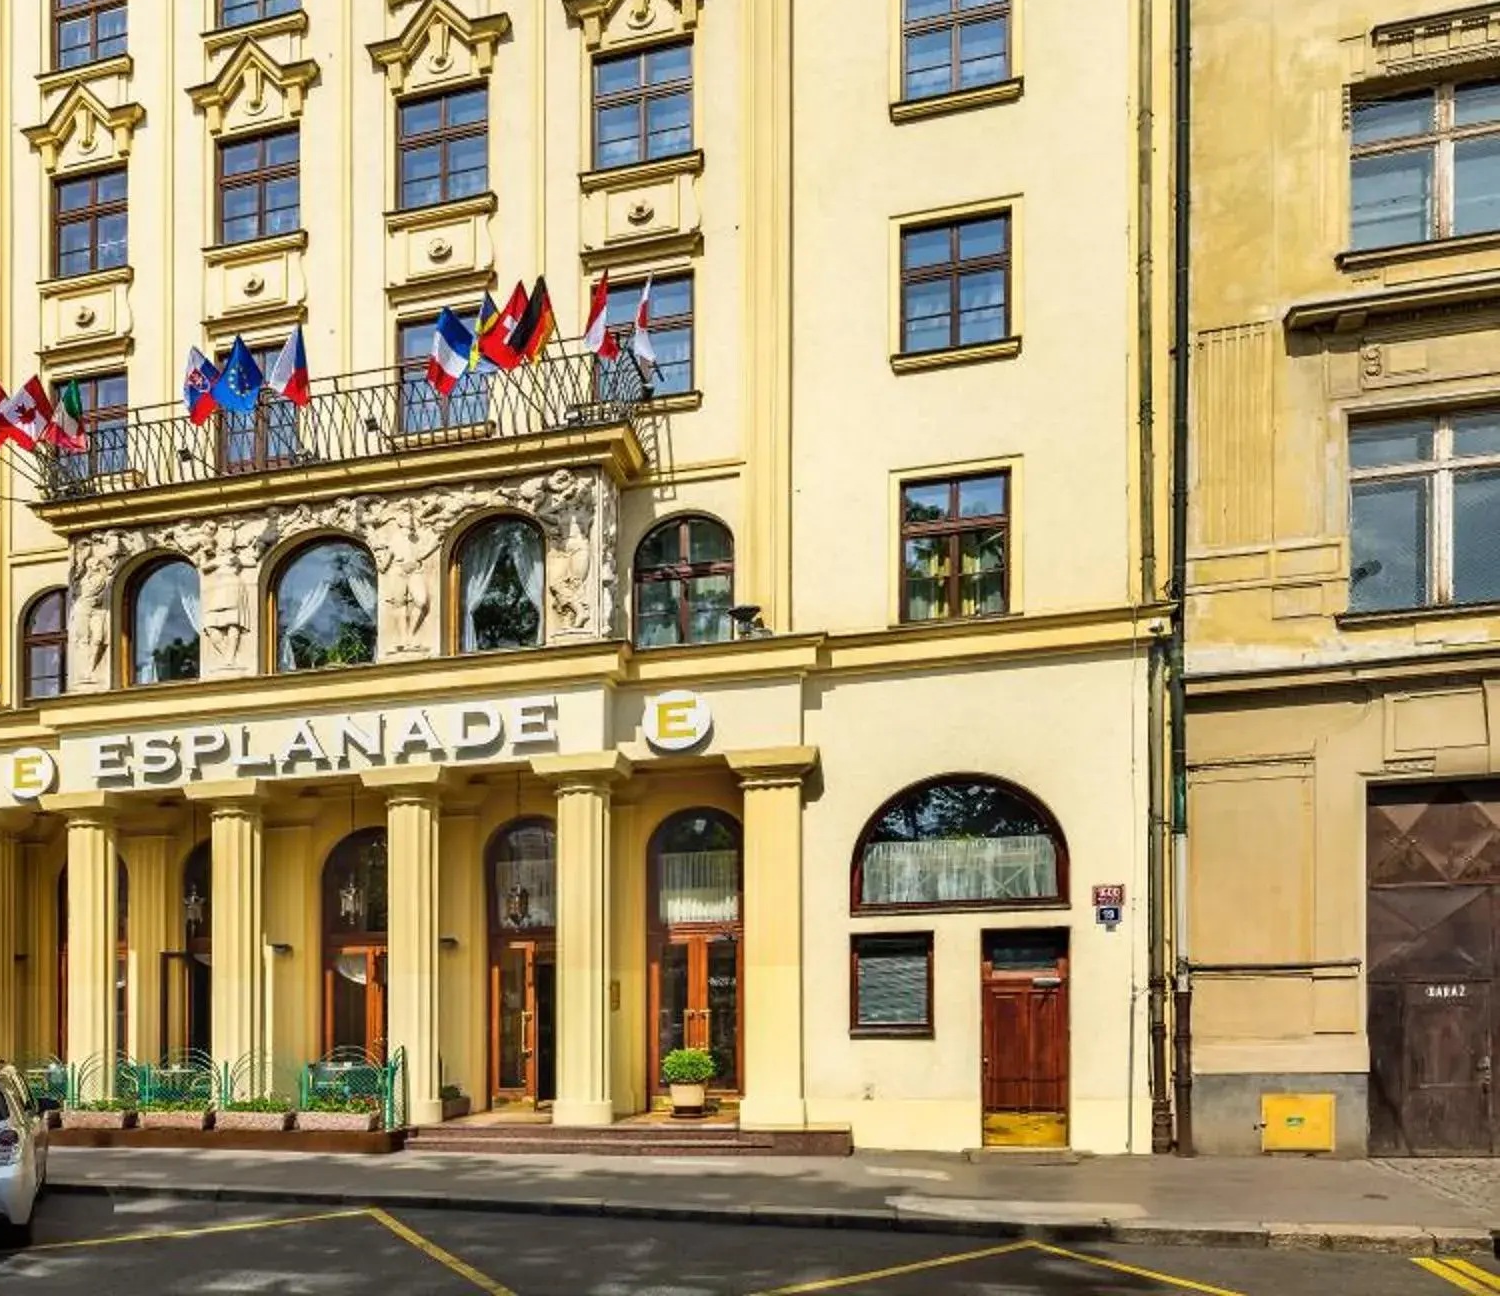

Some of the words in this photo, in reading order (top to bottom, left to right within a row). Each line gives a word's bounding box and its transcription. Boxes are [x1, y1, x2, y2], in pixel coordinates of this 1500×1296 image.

[92, 696, 560, 779] ESPLANADE
[656, 699, 697, 738] E
[13, 755, 43, 789] E
